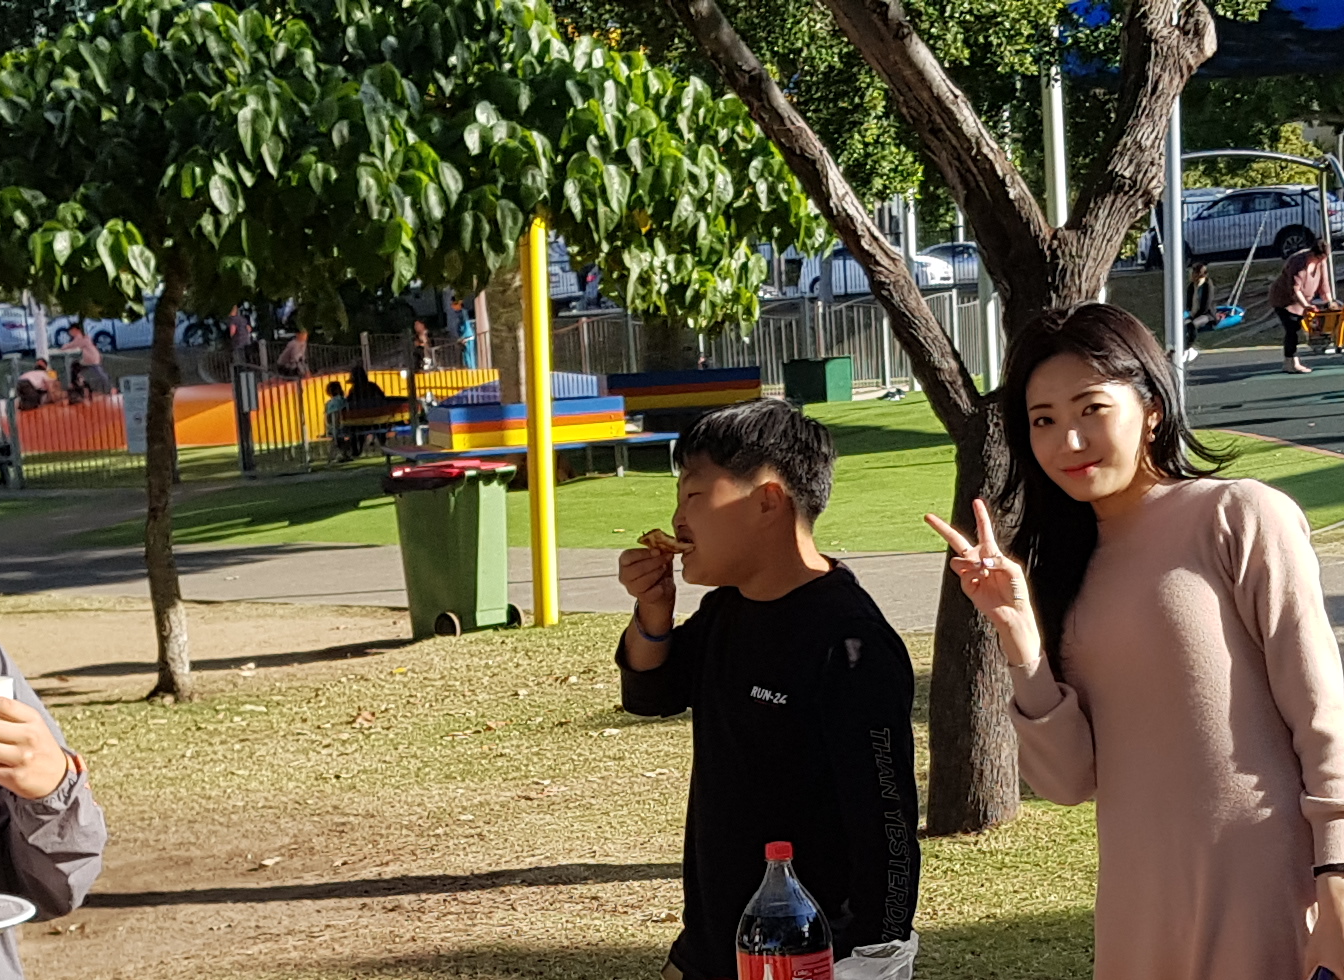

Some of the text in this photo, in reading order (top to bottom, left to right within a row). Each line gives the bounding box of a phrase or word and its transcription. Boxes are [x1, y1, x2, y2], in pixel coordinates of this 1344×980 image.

[750, 685, 788, 704] RUN-24
[870, 727, 911, 943] THAN YESTERDA
